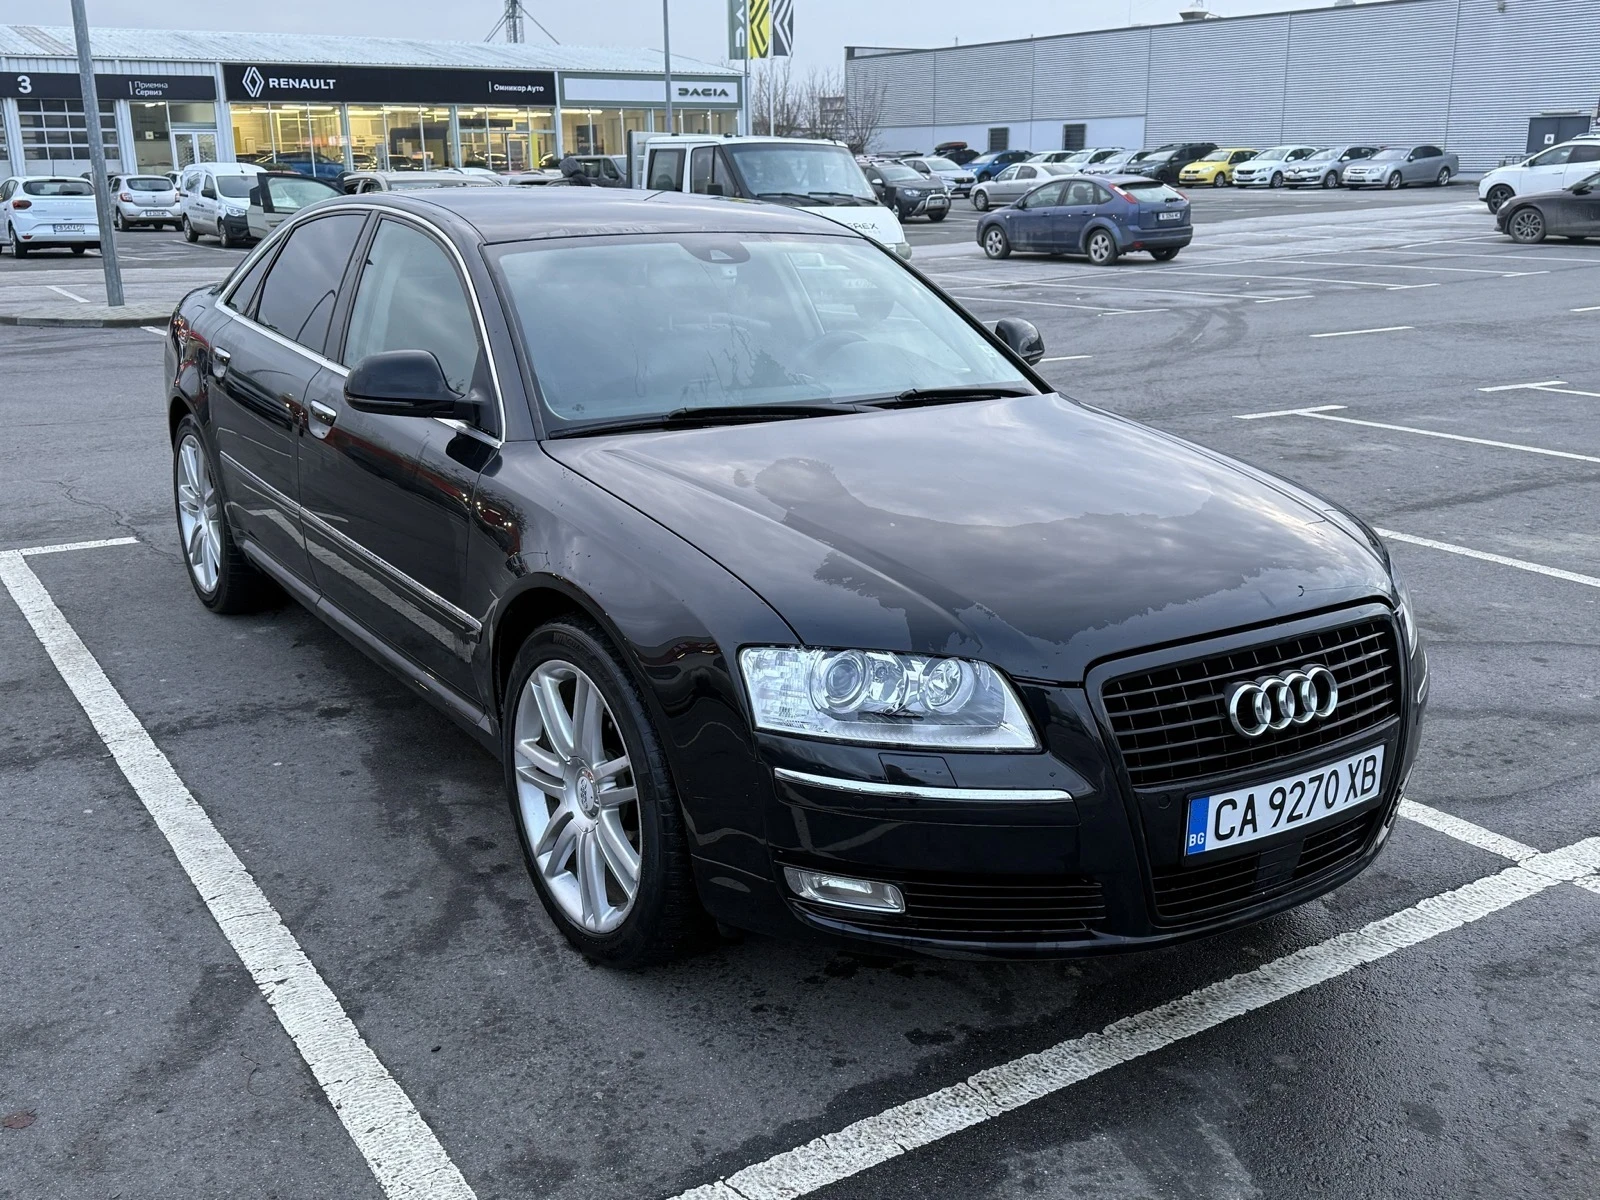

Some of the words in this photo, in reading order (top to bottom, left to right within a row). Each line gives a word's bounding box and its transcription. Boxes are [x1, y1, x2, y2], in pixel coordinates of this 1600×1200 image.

[17, 75, 32, 94] 3
[134, 80, 169, 89] Приемна
[269, 77, 336, 90] RENAULT
[527, 85, 544, 93] Ауто
[135, 88, 163, 97] Сервиз
[678, 87, 729, 97] DACIA
[1214, 793, 1258, 841] CA
[1269, 769, 1340, 828] 9270
[1343, 754, 1377, 803] XB
[1189, 832, 1204, 846] BG
